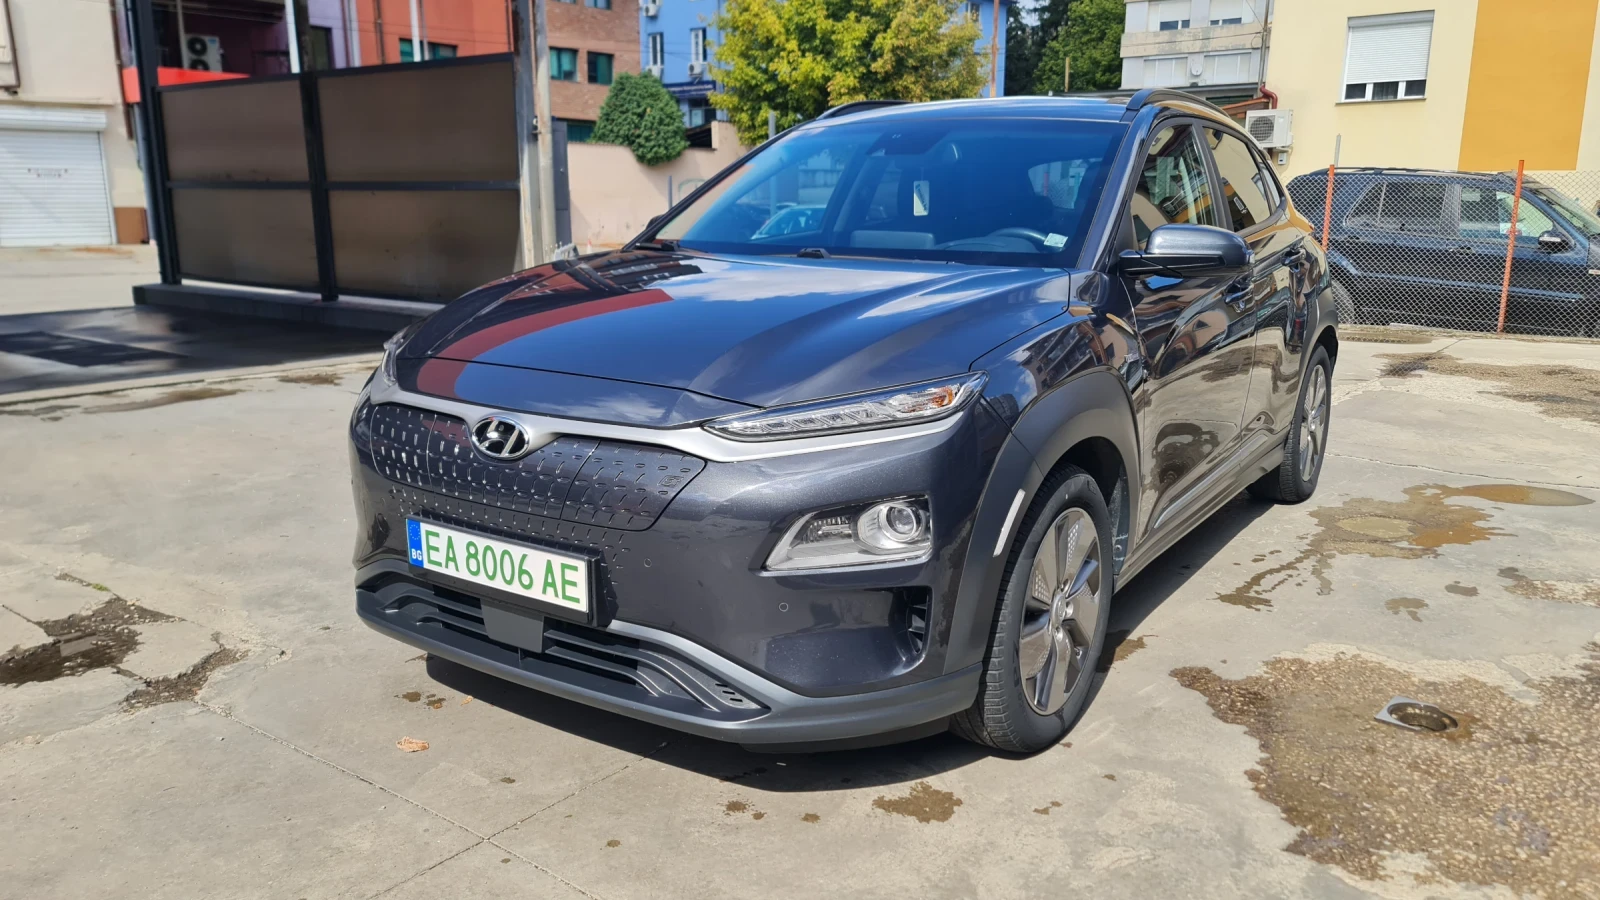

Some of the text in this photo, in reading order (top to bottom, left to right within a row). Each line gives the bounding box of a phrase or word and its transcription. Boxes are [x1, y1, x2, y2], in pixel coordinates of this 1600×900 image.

[411, 548, 422, 560] BG
[425, 530, 580, 604] EA 8006 AE
